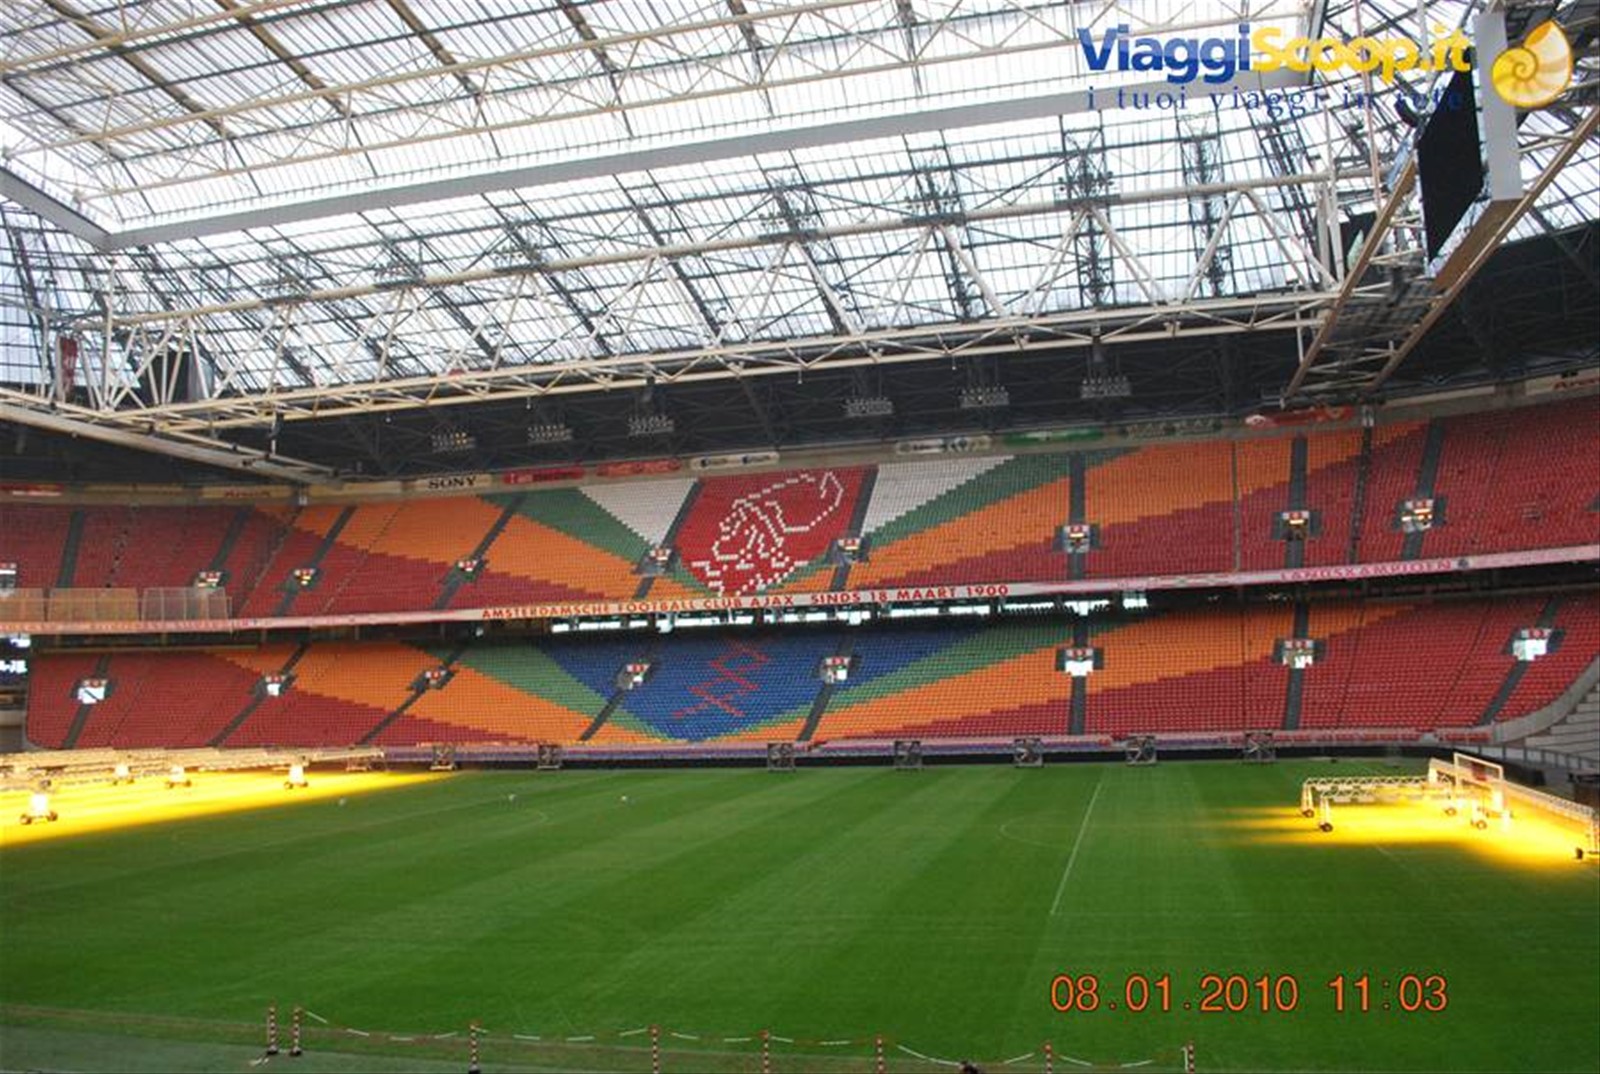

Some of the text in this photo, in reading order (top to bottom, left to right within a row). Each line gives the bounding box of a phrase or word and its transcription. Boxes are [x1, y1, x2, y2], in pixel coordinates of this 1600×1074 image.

[428, 475, 478, 489] SONY
[482, 584, 1009, 618] AMSTERDAMSCHE FOOTBALL CLUB AJAX SINDS 18 MAART 1900
